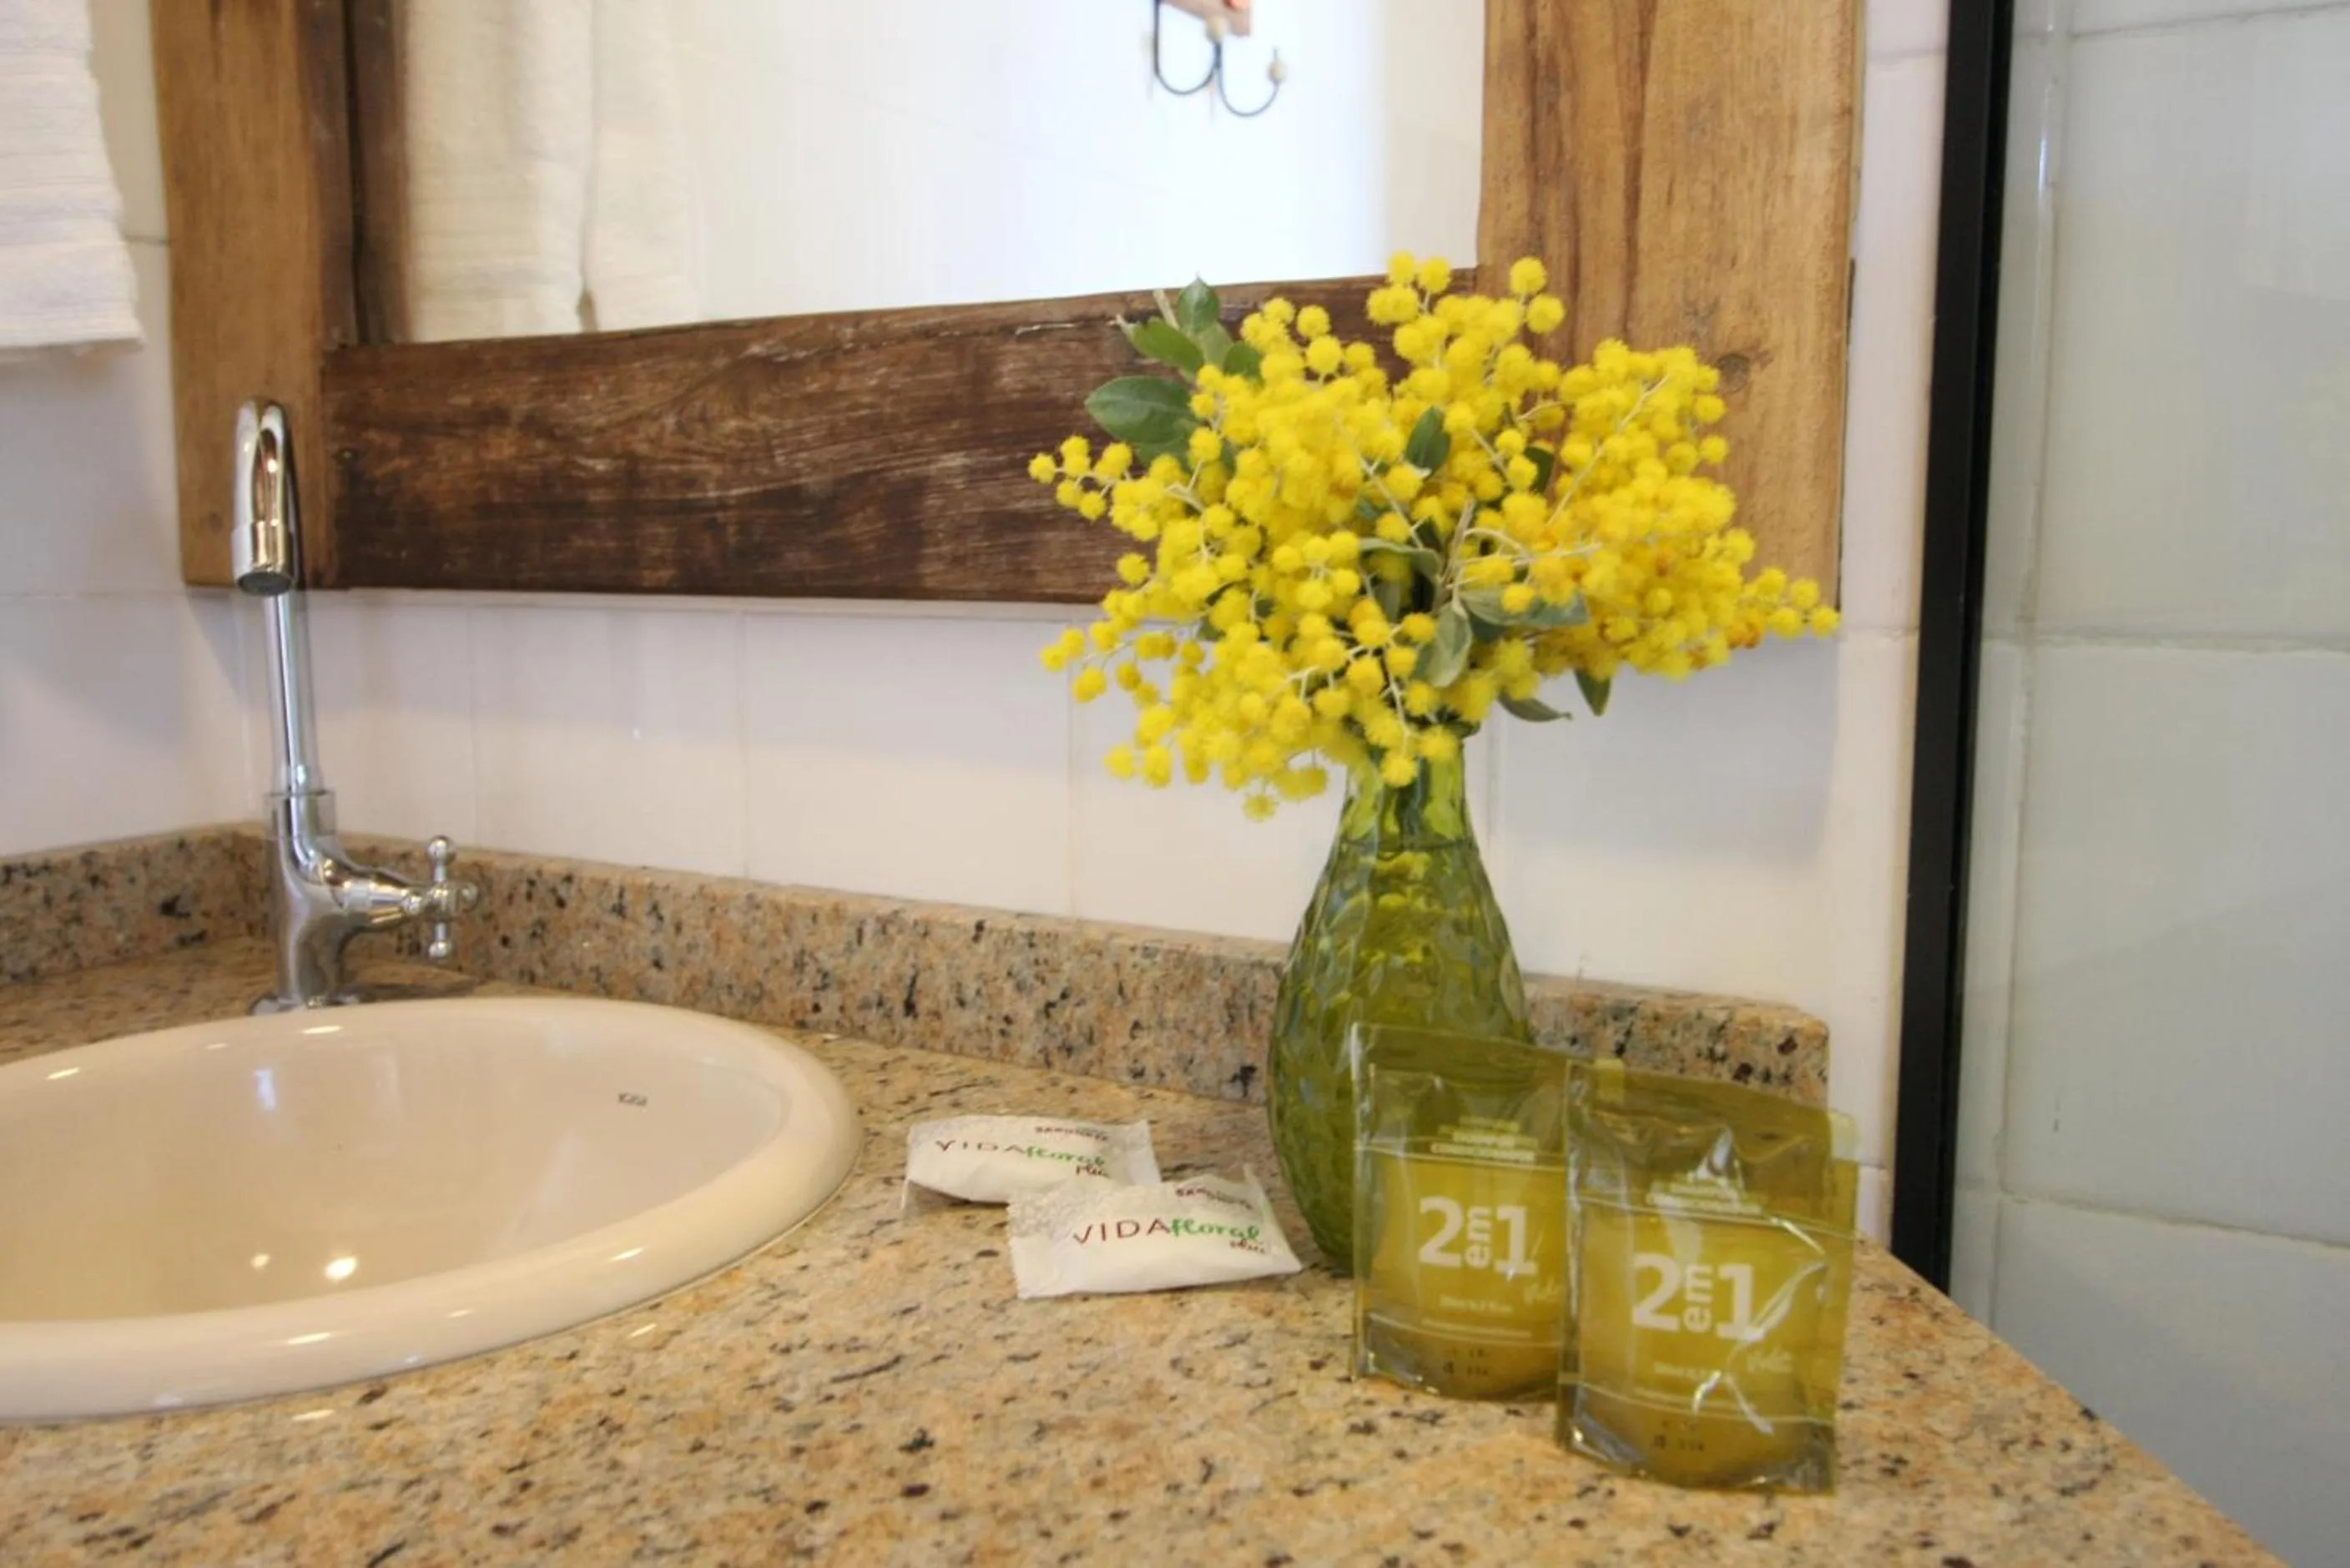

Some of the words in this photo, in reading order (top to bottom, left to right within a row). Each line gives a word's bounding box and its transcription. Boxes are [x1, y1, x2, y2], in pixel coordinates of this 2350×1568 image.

[1419, 1195, 1465, 1268] 2
[1495, 1205, 1538, 1275] 1
[1631, 1252, 1681, 1333] 2
[1716, 1263, 1762, 1341] 1
